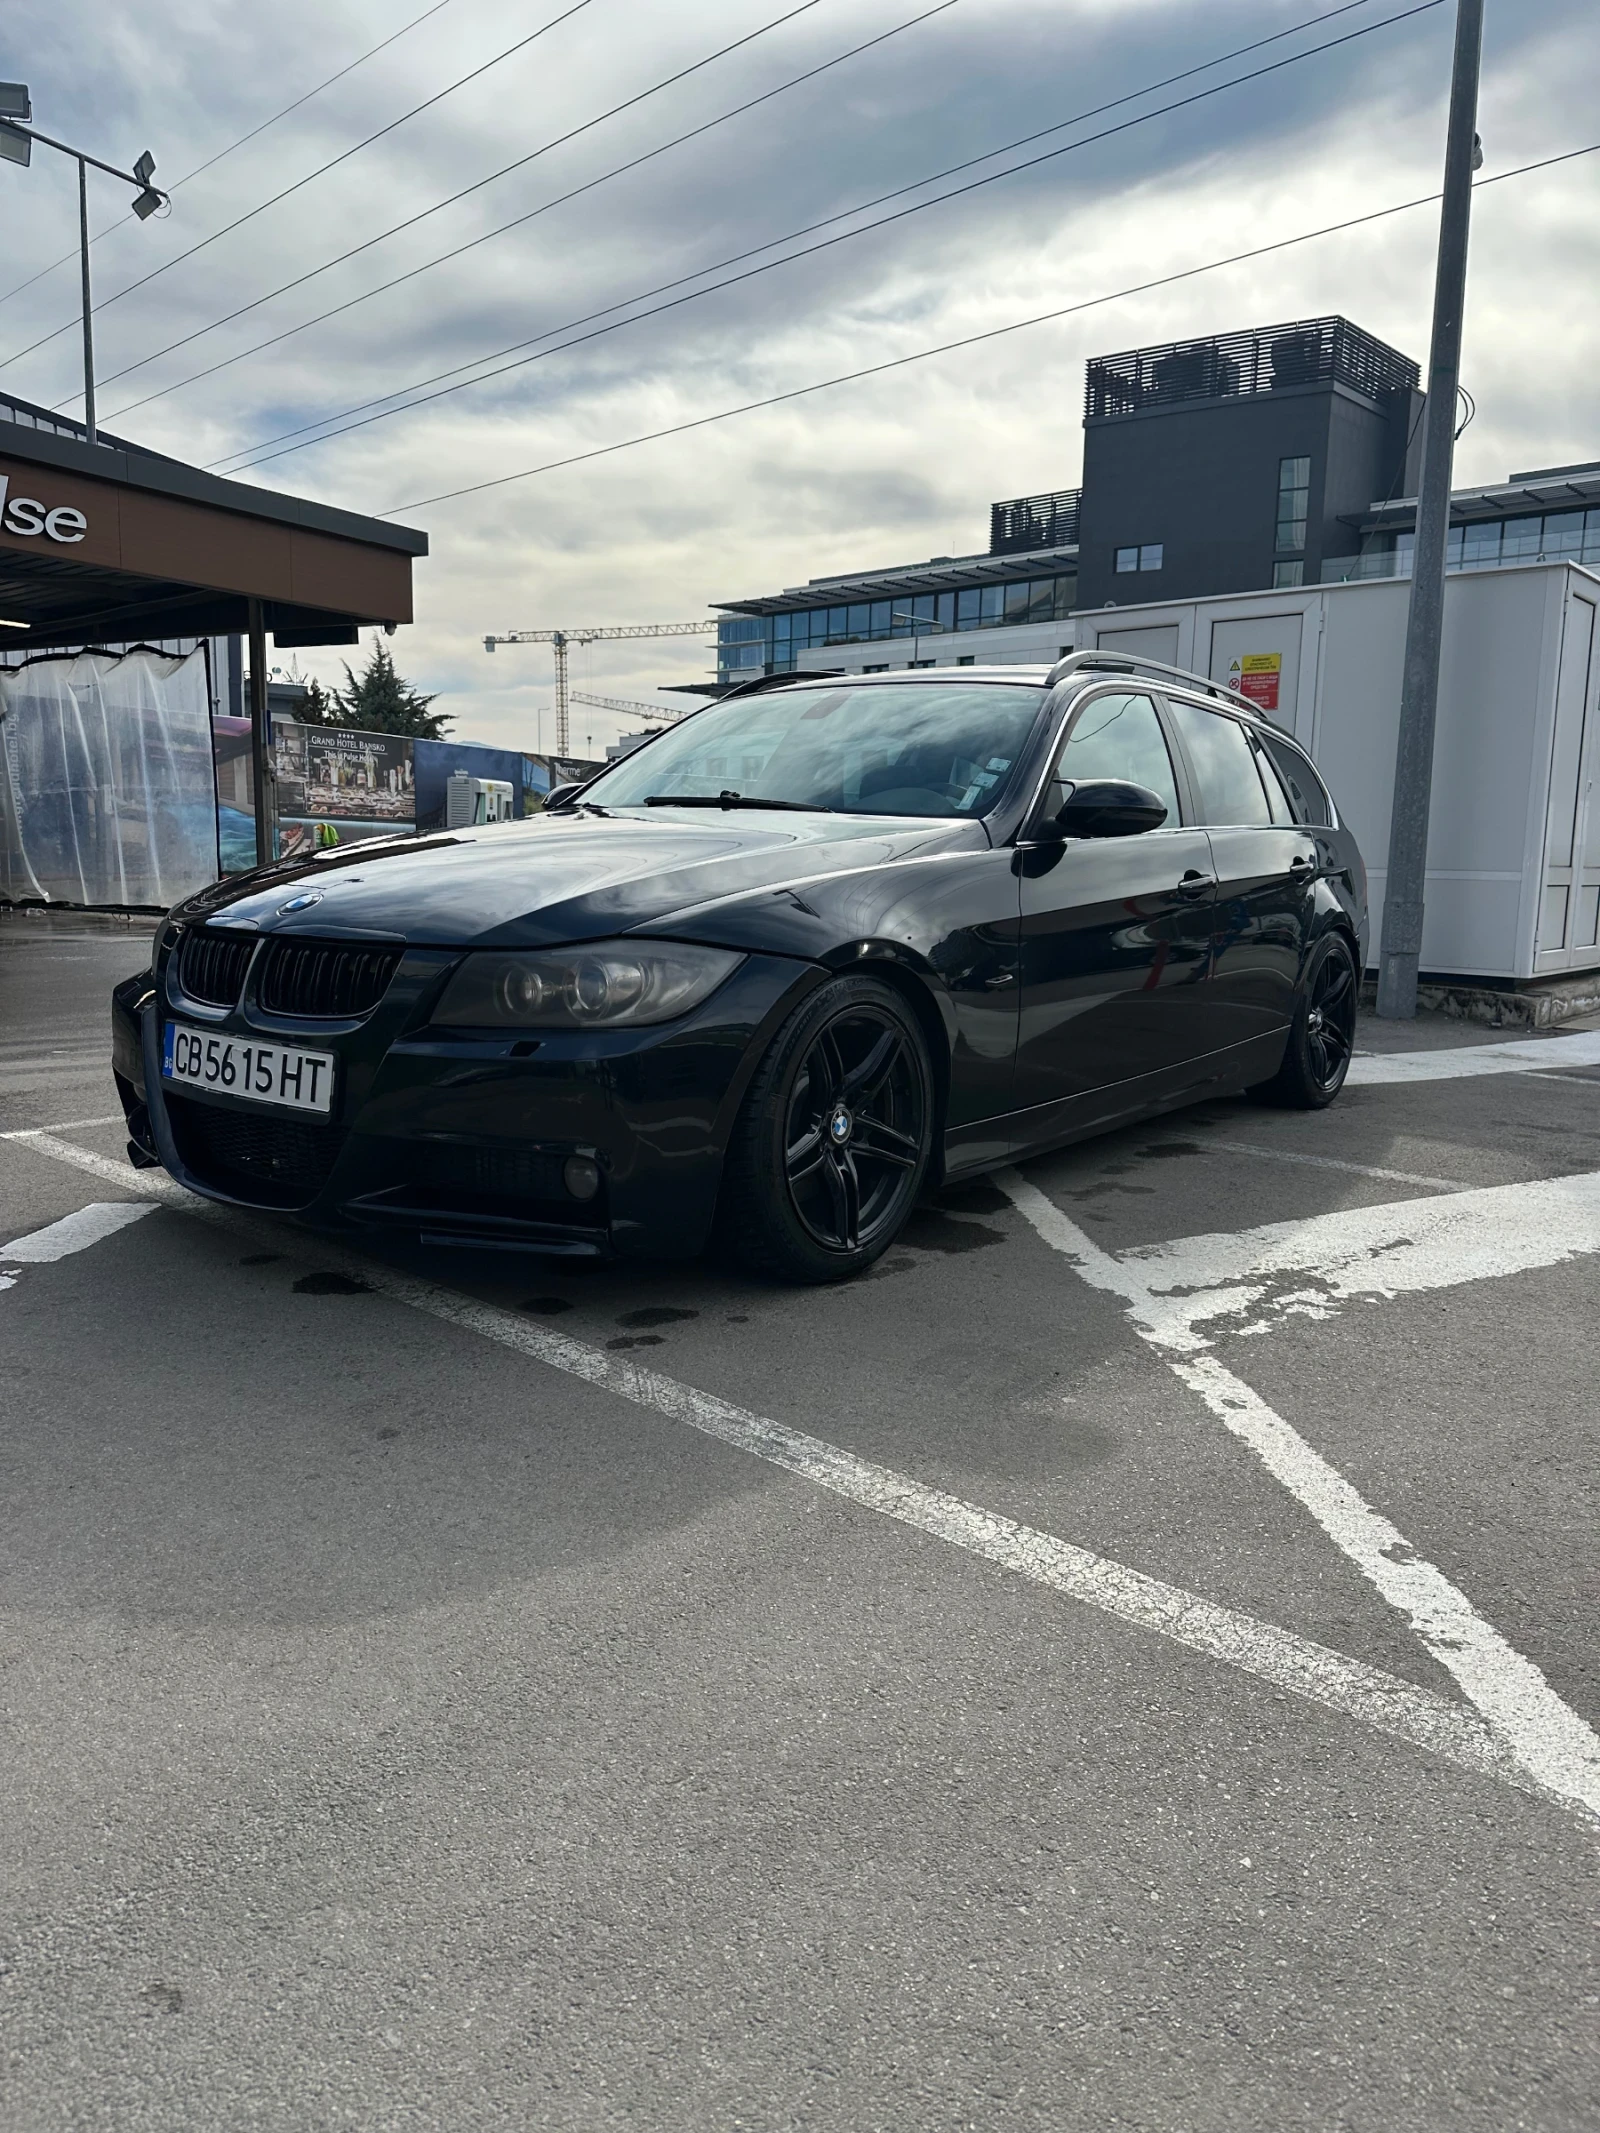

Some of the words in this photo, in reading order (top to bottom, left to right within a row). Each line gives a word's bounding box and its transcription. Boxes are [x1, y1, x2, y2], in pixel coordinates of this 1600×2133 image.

[311, 735, 335, 746] GRAND
[336, 738, 358, 749] HOTEL
[343, 752, 358, 761] Pulse
[554, 761, 581, 777] Therme
[164, 1056, 173, 1069] BG
